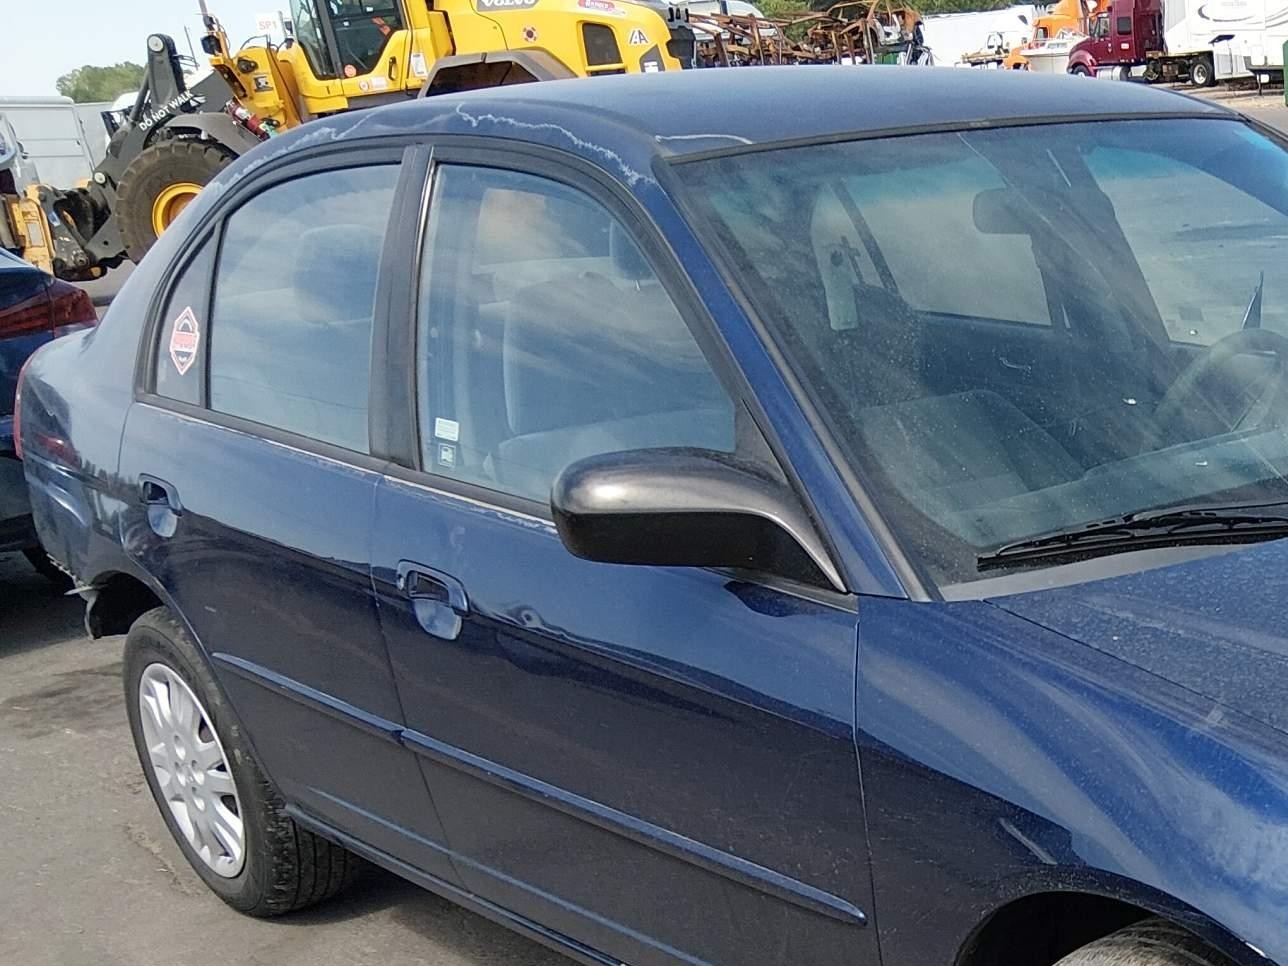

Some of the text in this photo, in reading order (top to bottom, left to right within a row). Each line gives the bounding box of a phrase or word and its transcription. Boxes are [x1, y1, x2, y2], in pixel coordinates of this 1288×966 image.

[138, 89, 194, 132] DO NOT WALK
